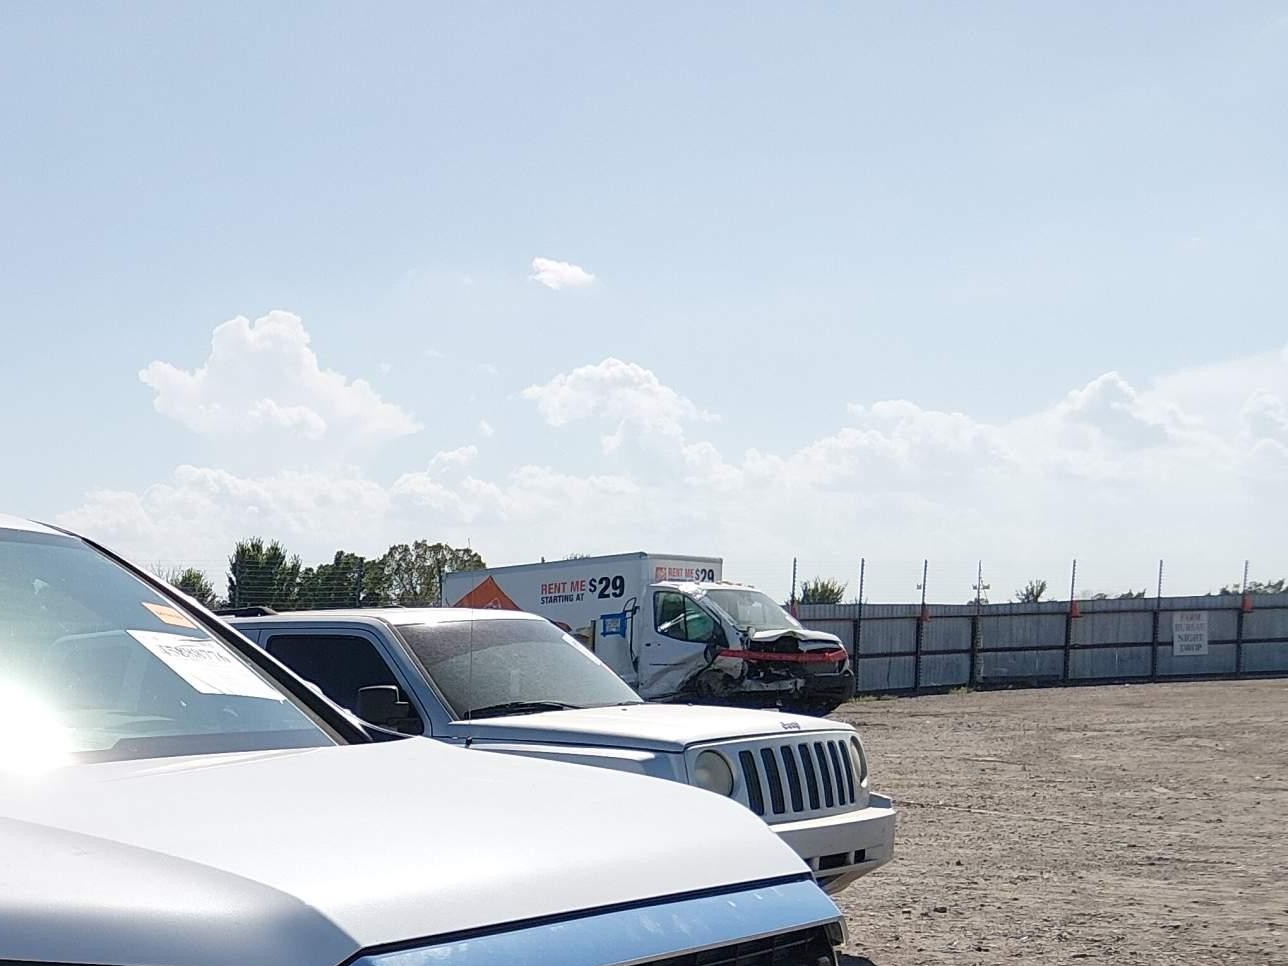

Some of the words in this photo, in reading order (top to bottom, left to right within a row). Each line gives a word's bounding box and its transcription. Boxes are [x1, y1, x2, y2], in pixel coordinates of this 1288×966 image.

[541, 582, 567, 595] RENT
[570, 580, 586, 592] ME
[588, 575, 625, 600] $29
[540, 594, 574, 605] STARTING
[576, 593, 585, 601] AT
